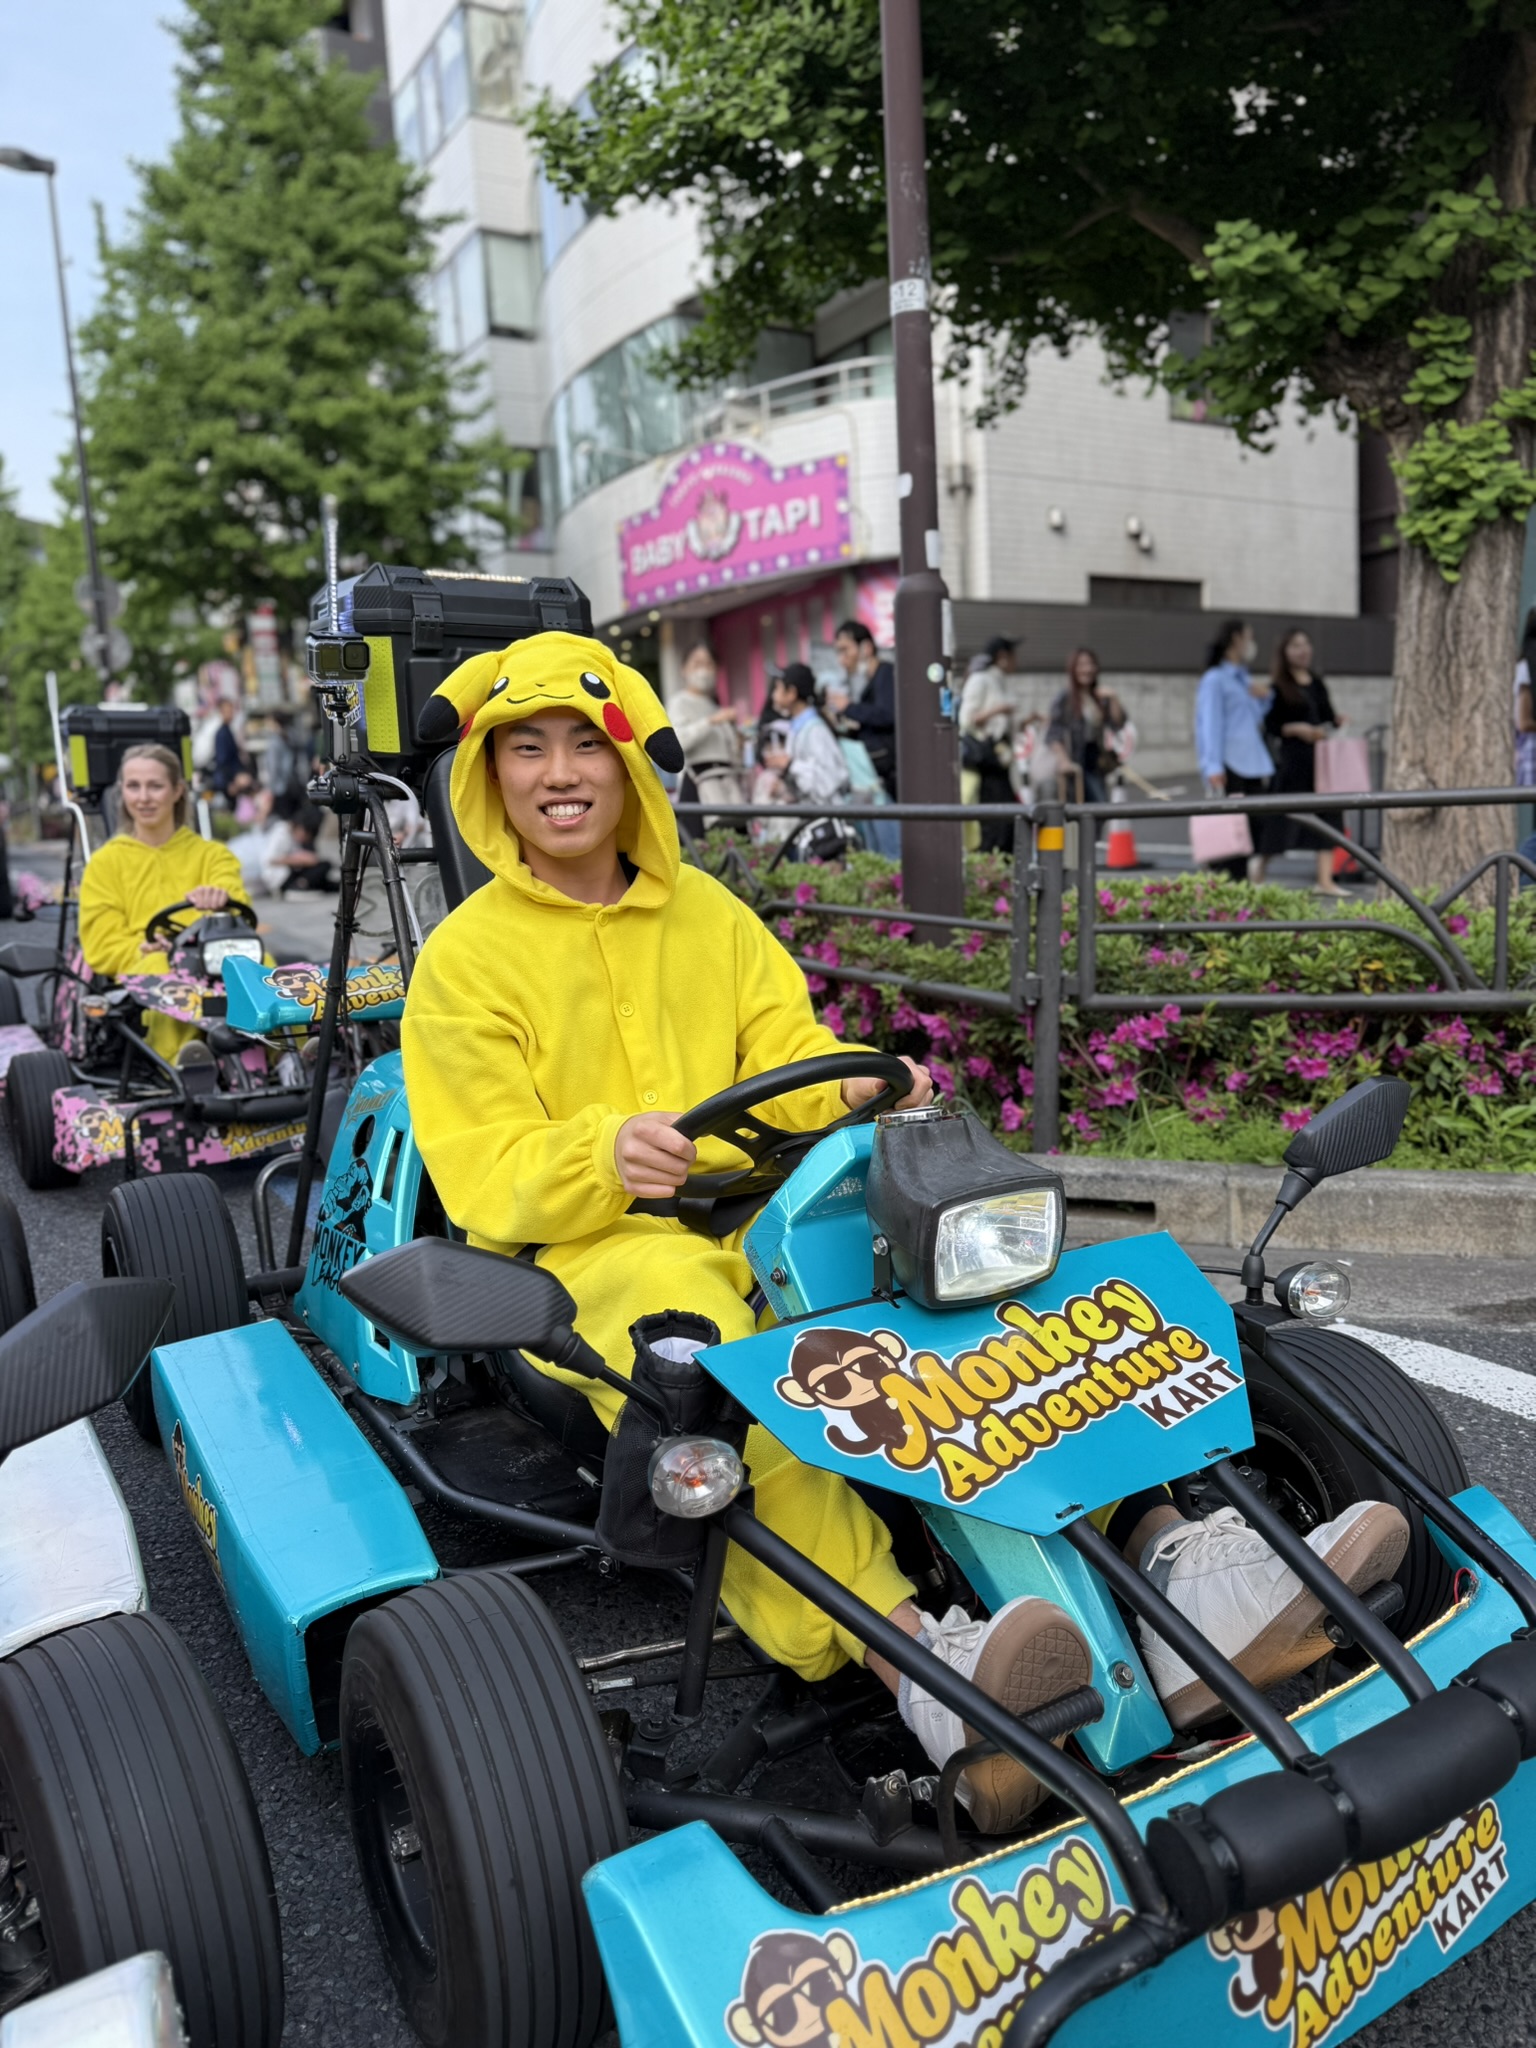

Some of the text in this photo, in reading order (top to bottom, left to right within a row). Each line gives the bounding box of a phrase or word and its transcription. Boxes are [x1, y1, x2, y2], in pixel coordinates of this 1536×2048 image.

[743, 496, 820, 540] TAPI
[311, 1222, 367, 1273] MONKEY
[878, 1280, 1160, 1466] Monkey
[936, 1328, 1205, 1498] Adventure
[1138, 1358, 1245, 1429] KART
[824, 1844, 1106, 2048] Monkey
[1294, 1806, 1498, 2048] Adventure
[1431, 1845, 1508, 1950] KART
